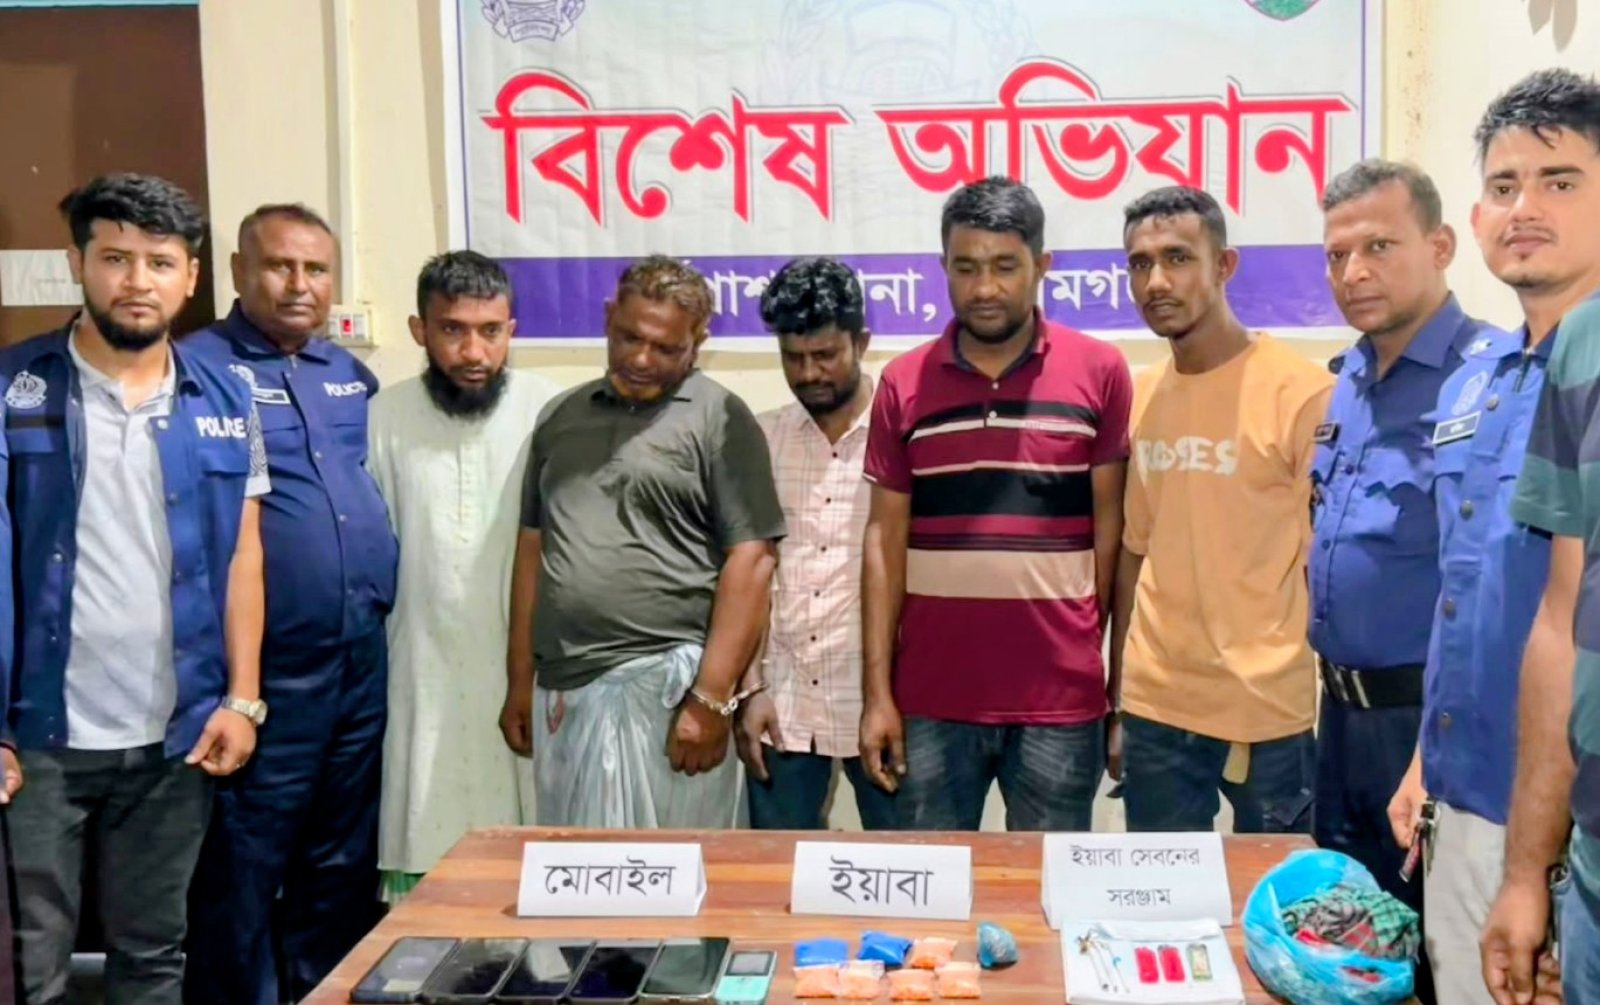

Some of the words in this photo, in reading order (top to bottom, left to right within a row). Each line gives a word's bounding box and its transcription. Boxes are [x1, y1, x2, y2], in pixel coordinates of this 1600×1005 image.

[480, 71, 853, 225] বিশেষ
[874, 60, 1354, 216] অভিযান
[543, 855, 676, 896] মোবাইল
[1069, 844, 1122, 866] ইয়াবা
[1130, 848, 1200, 866] সেবনের
[828, 855, 934, 906] ইয়াবা
[1106, 888, 1171, 906] সরঞ্জাম
